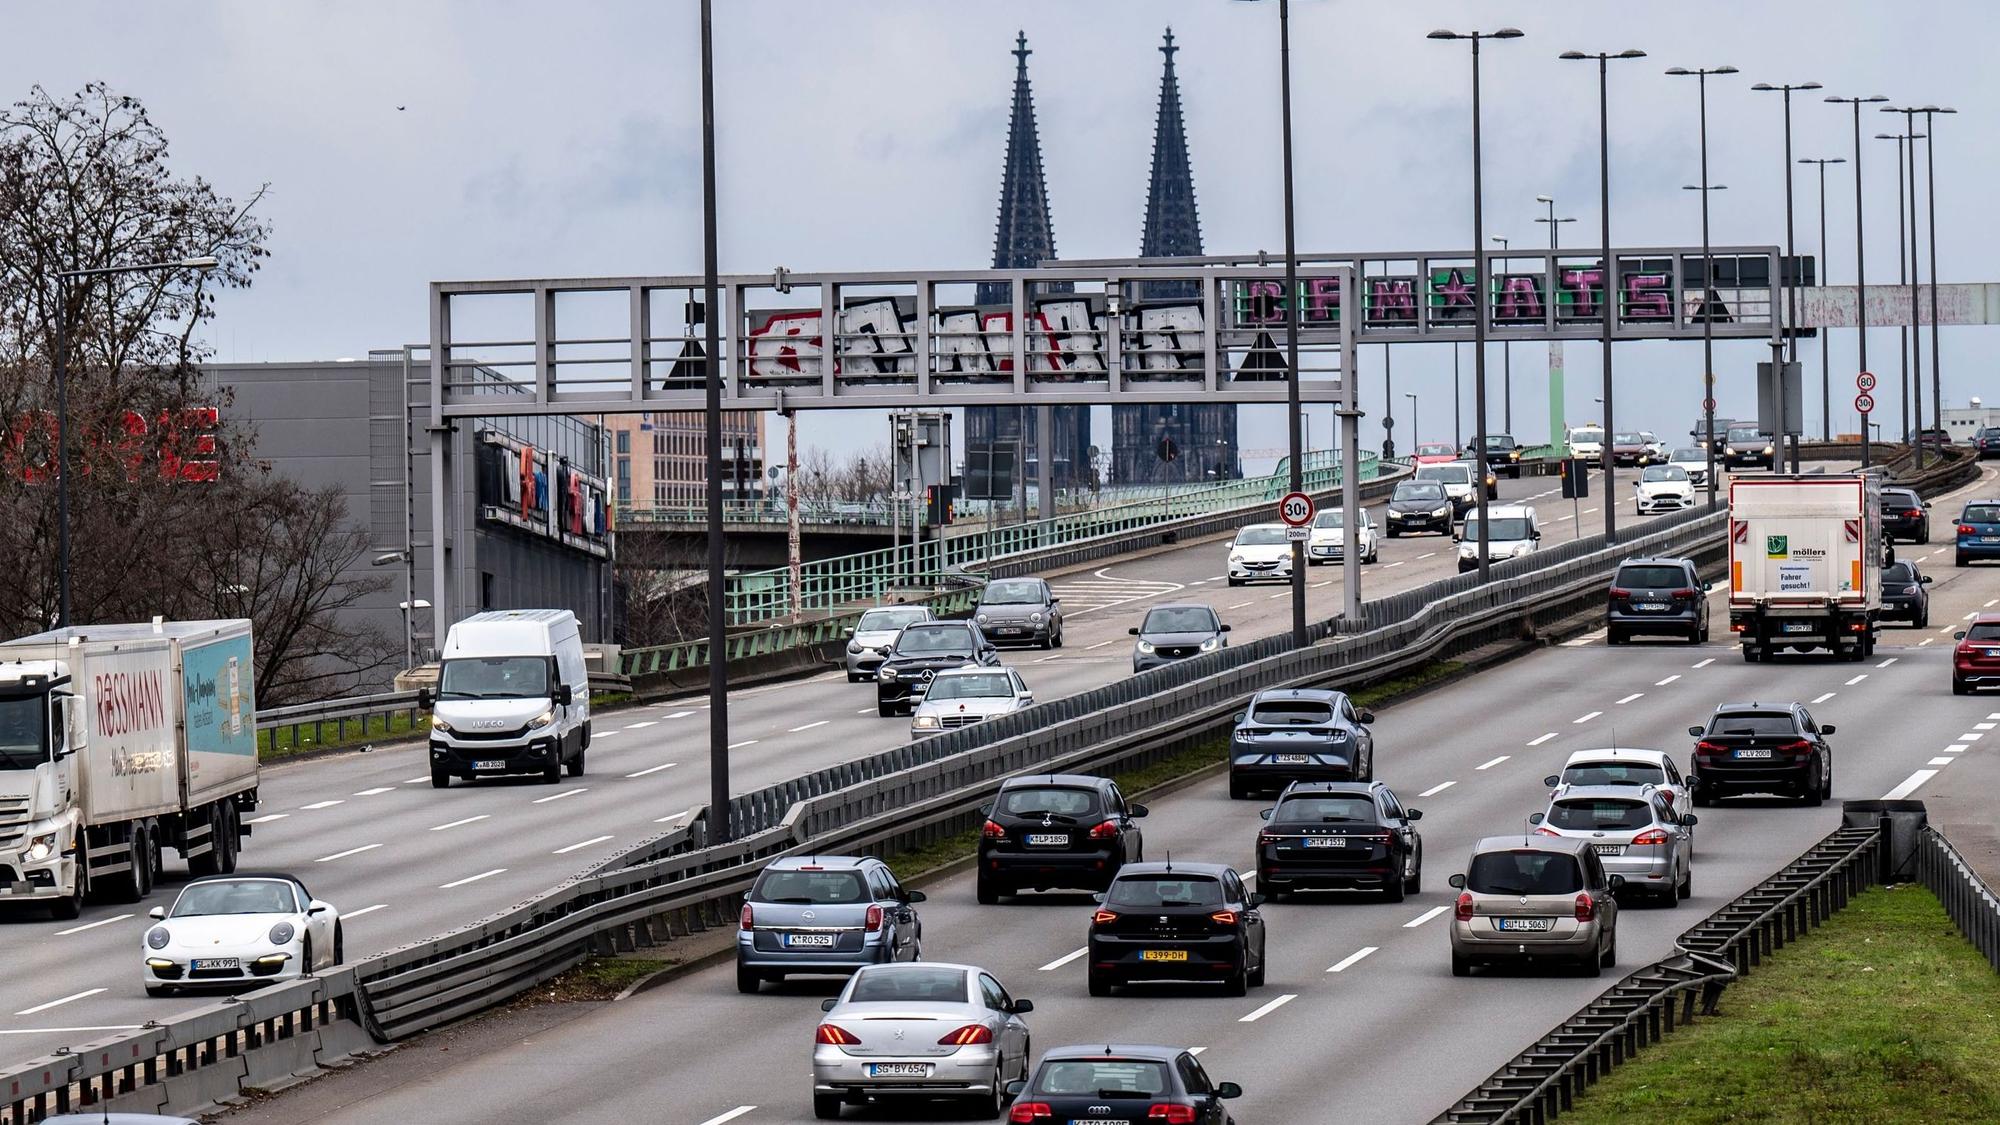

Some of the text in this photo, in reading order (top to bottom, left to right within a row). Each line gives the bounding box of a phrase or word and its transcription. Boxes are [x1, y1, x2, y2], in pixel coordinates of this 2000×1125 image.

[1860, 377, 1872, 387] 80
[1858, 399, 1871, 407] 30t
[1285, 502, 1307, 517] 30t
[1780, 573, 1802, 581] Fahrer
[96, 669, 165, 739] ROSSMANN
[472, 720, 504, 729] IVECO
